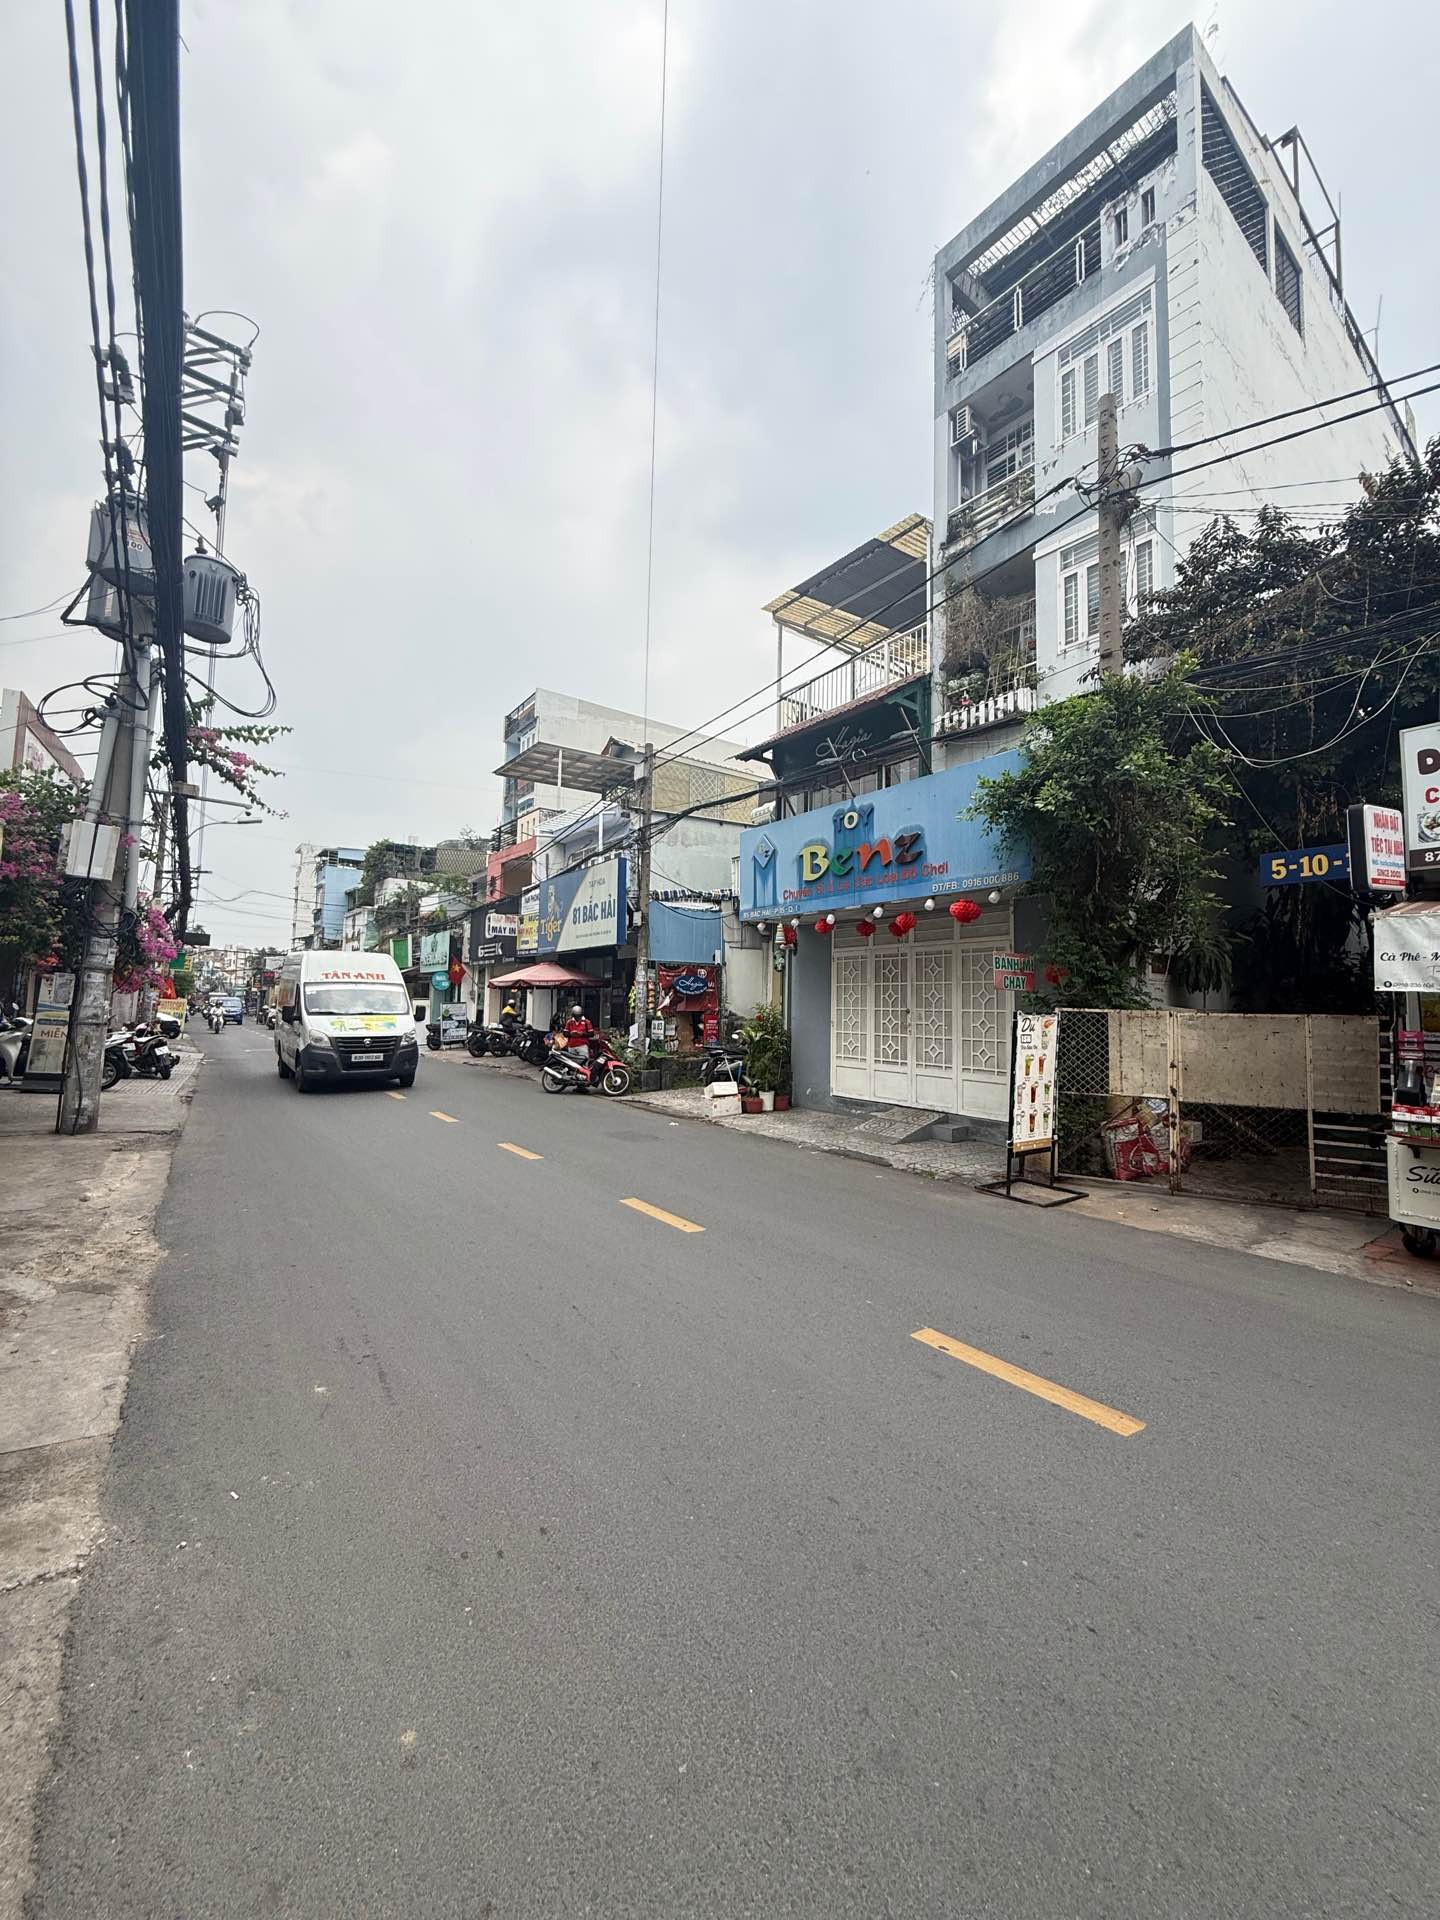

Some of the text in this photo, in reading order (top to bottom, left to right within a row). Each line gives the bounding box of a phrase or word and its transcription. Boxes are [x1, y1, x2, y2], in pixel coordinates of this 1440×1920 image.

[833, 804, 875, 833] TOY
[800, 831, 924, 882] Benz
[572, 893, 616, 925] 81 BẮC HẢI
[353, 972, 385, 980] ANH
[1003, 975, 1026, 990] CHAY
